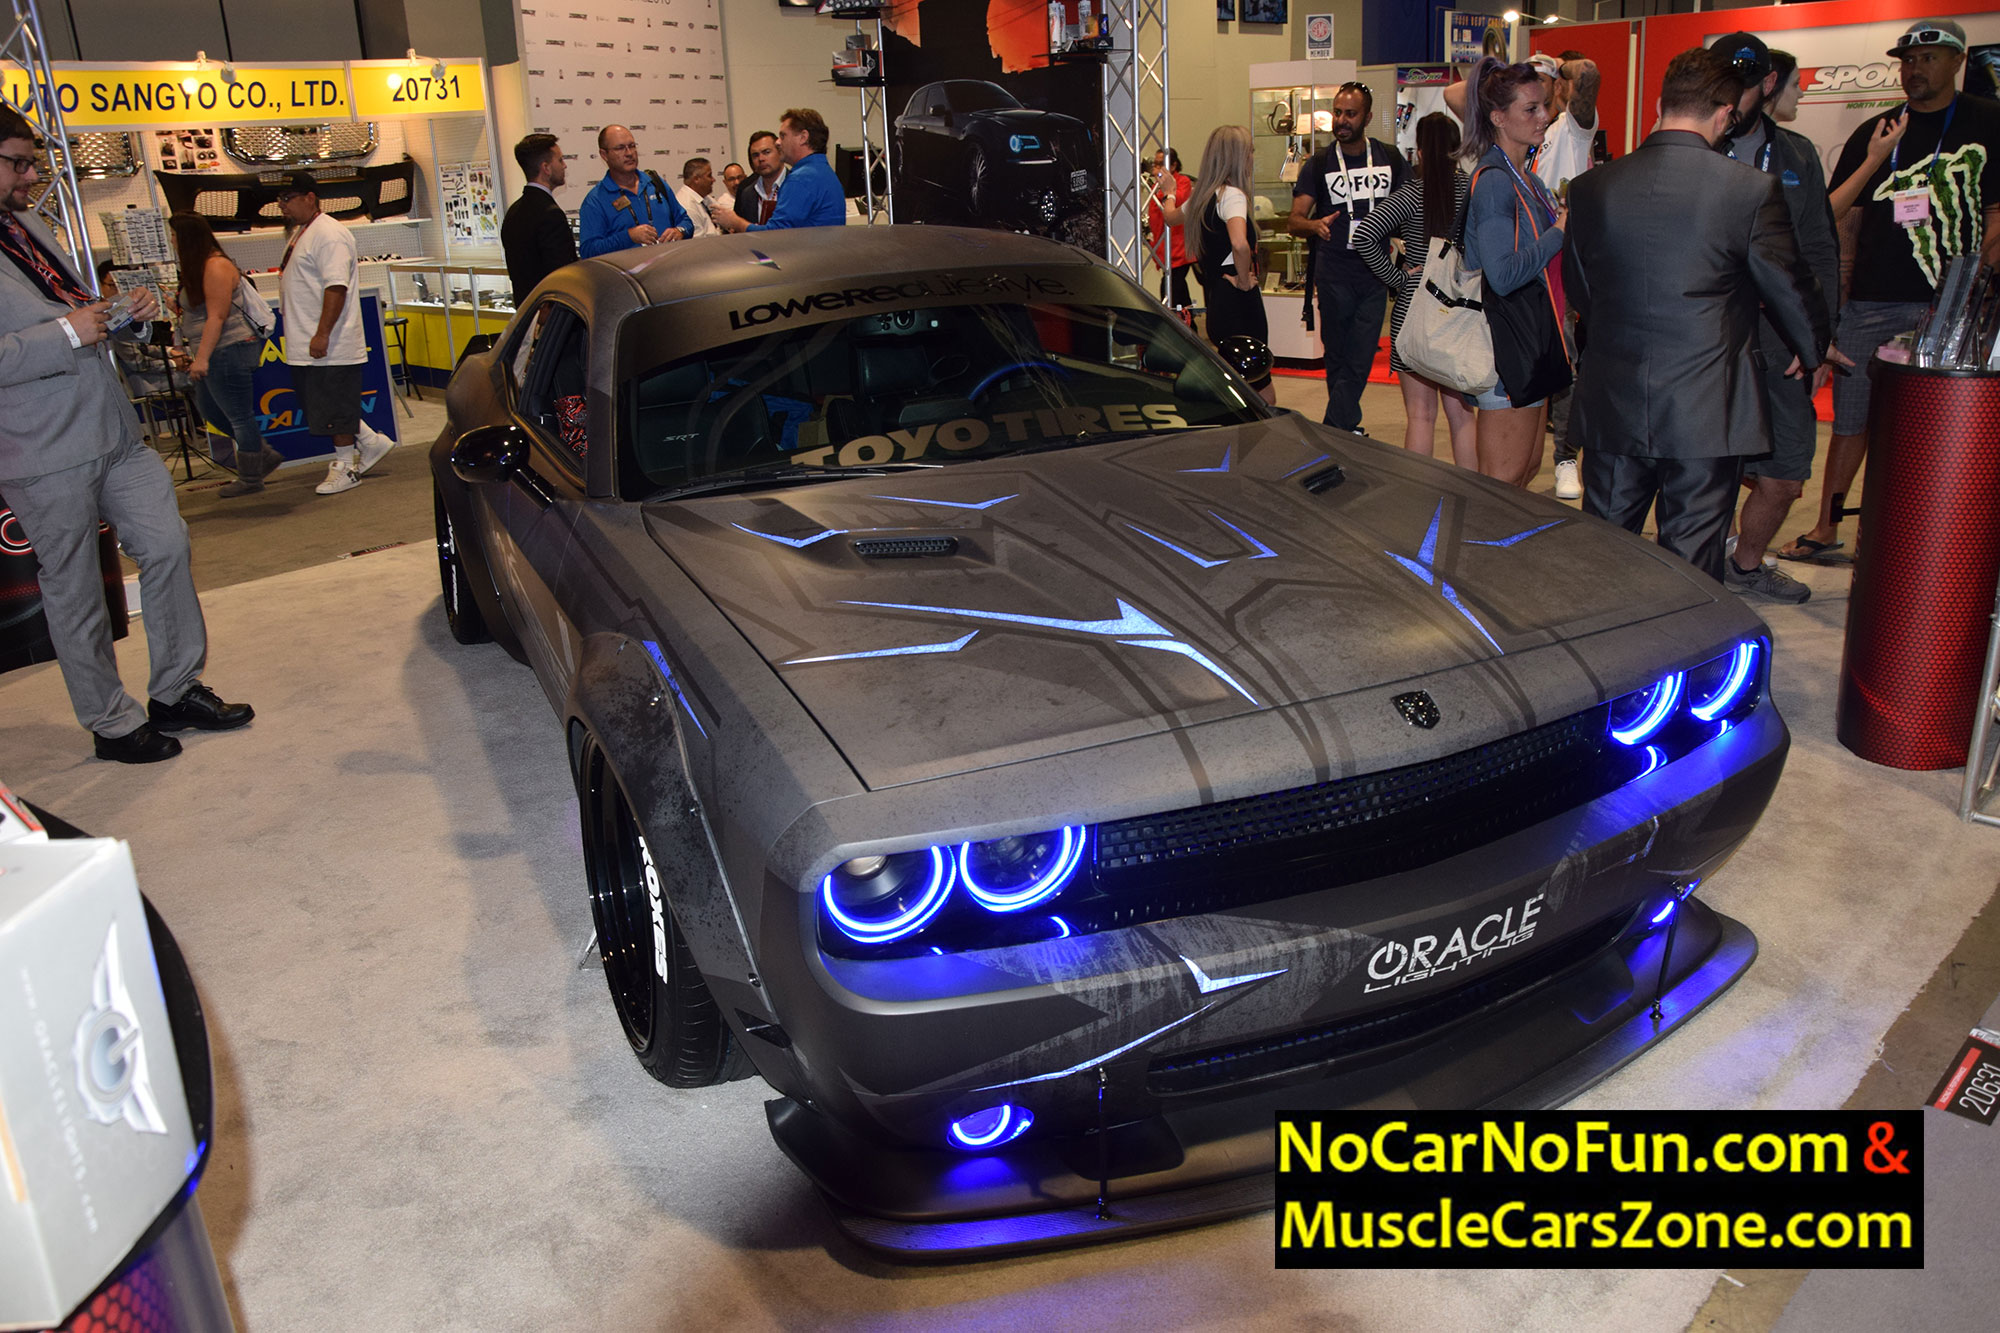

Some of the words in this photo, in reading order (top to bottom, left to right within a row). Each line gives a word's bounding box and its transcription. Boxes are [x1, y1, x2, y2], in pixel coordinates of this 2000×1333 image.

[1310, 49, 1330, 57] MEMBER
[90, 82, 217, 112] SANGYO
[227, 81, 281, 112] CO.,
[291, 80, 344, 107] LTD.
[392, 75, 460, 102] 20731
[1846, 102, 1876, 110] NORTH
[791, 418, 990, 467] TOYO
[992, 404, 1188, 442] TIRES
[1367, 893, 1545, 980] ORACLE
[1364, 928, 1535, 994] LIGHTING
[1959, 1062, 2000, 1116] 20631
